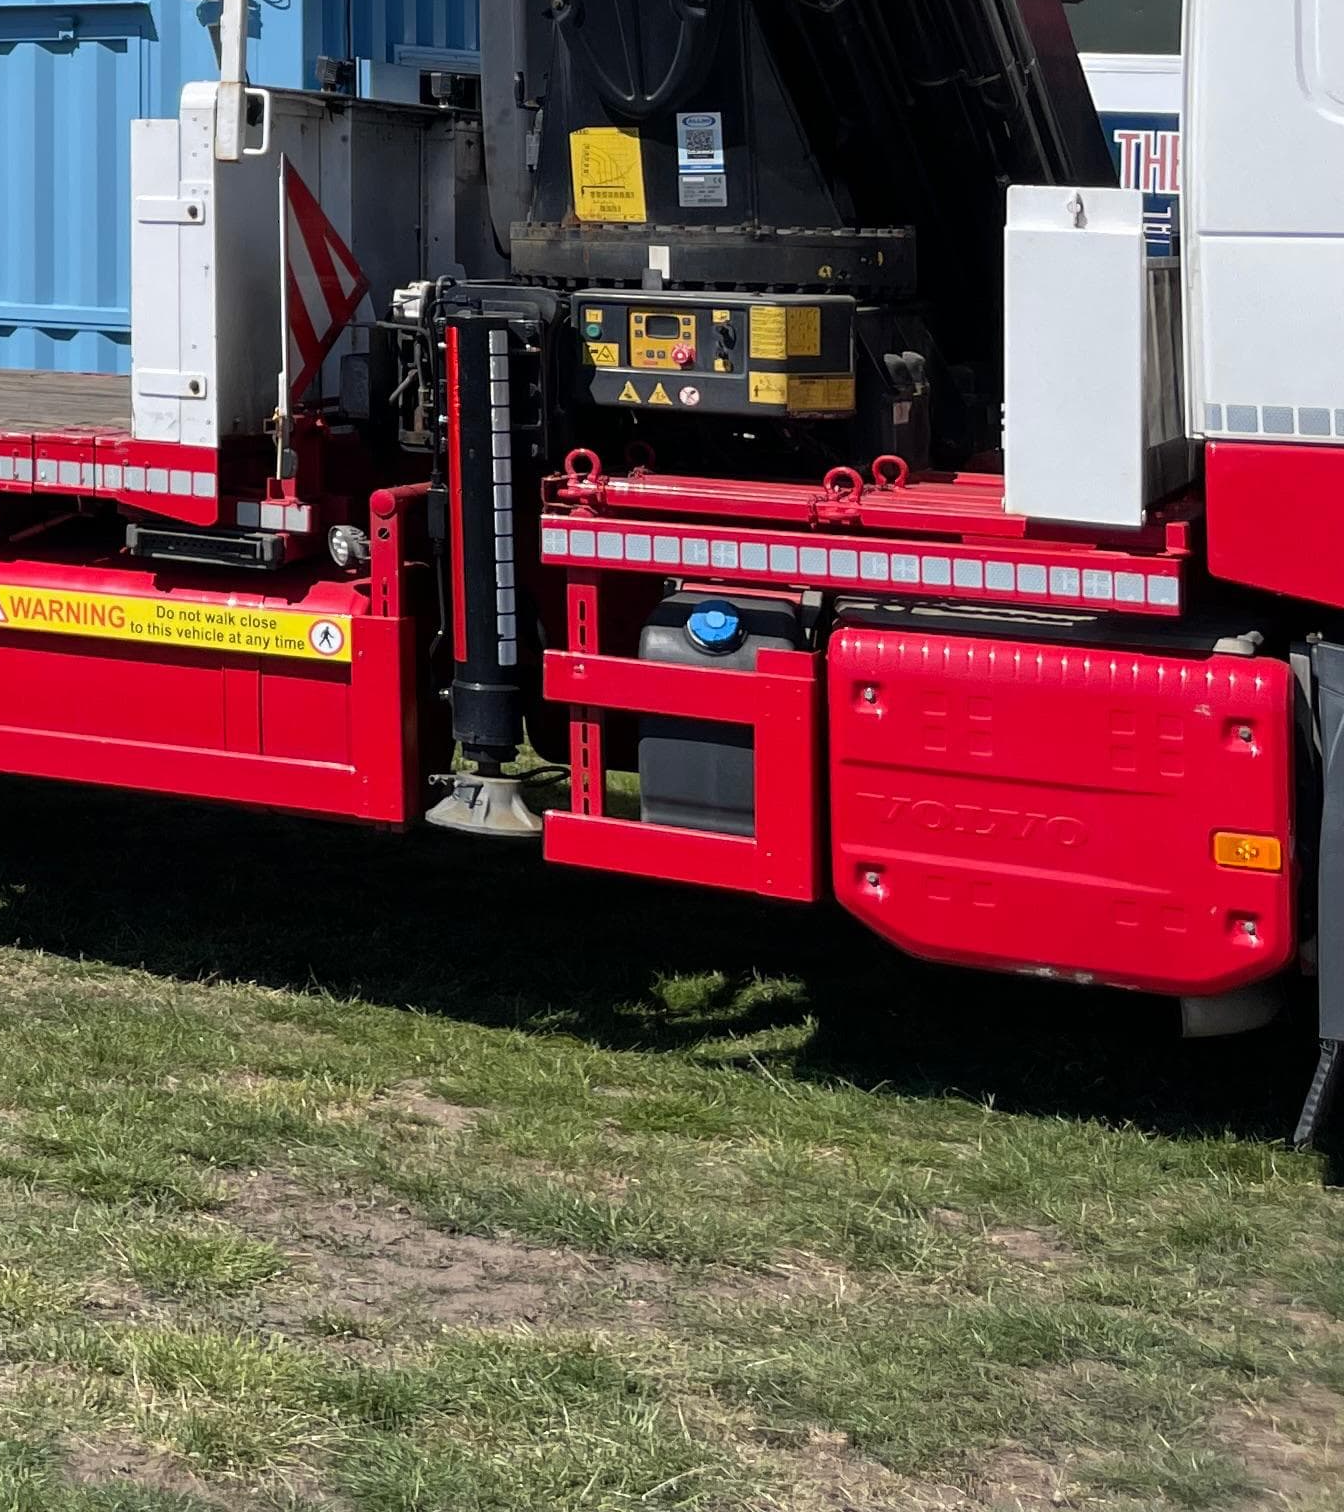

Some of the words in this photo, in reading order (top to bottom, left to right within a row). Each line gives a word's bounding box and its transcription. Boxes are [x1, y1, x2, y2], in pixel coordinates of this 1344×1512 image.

[10, 596, 126, 628] WARNING
[156, 605, 175, 619] Do
[179, 609, 201, 622] not
[205, 611, 236, 626] walk
[240, 614, 277, 629] close
[130, 621, 144, 634] to
[148, 622, 172, 637] this
[176, 625, 225, 643] vehicle
[228, 631, 242, 644] at
[246, 636, 271, 651] any
[275, 635, 305, 651] time
[855, 792, 1088, 847] VOLVO
